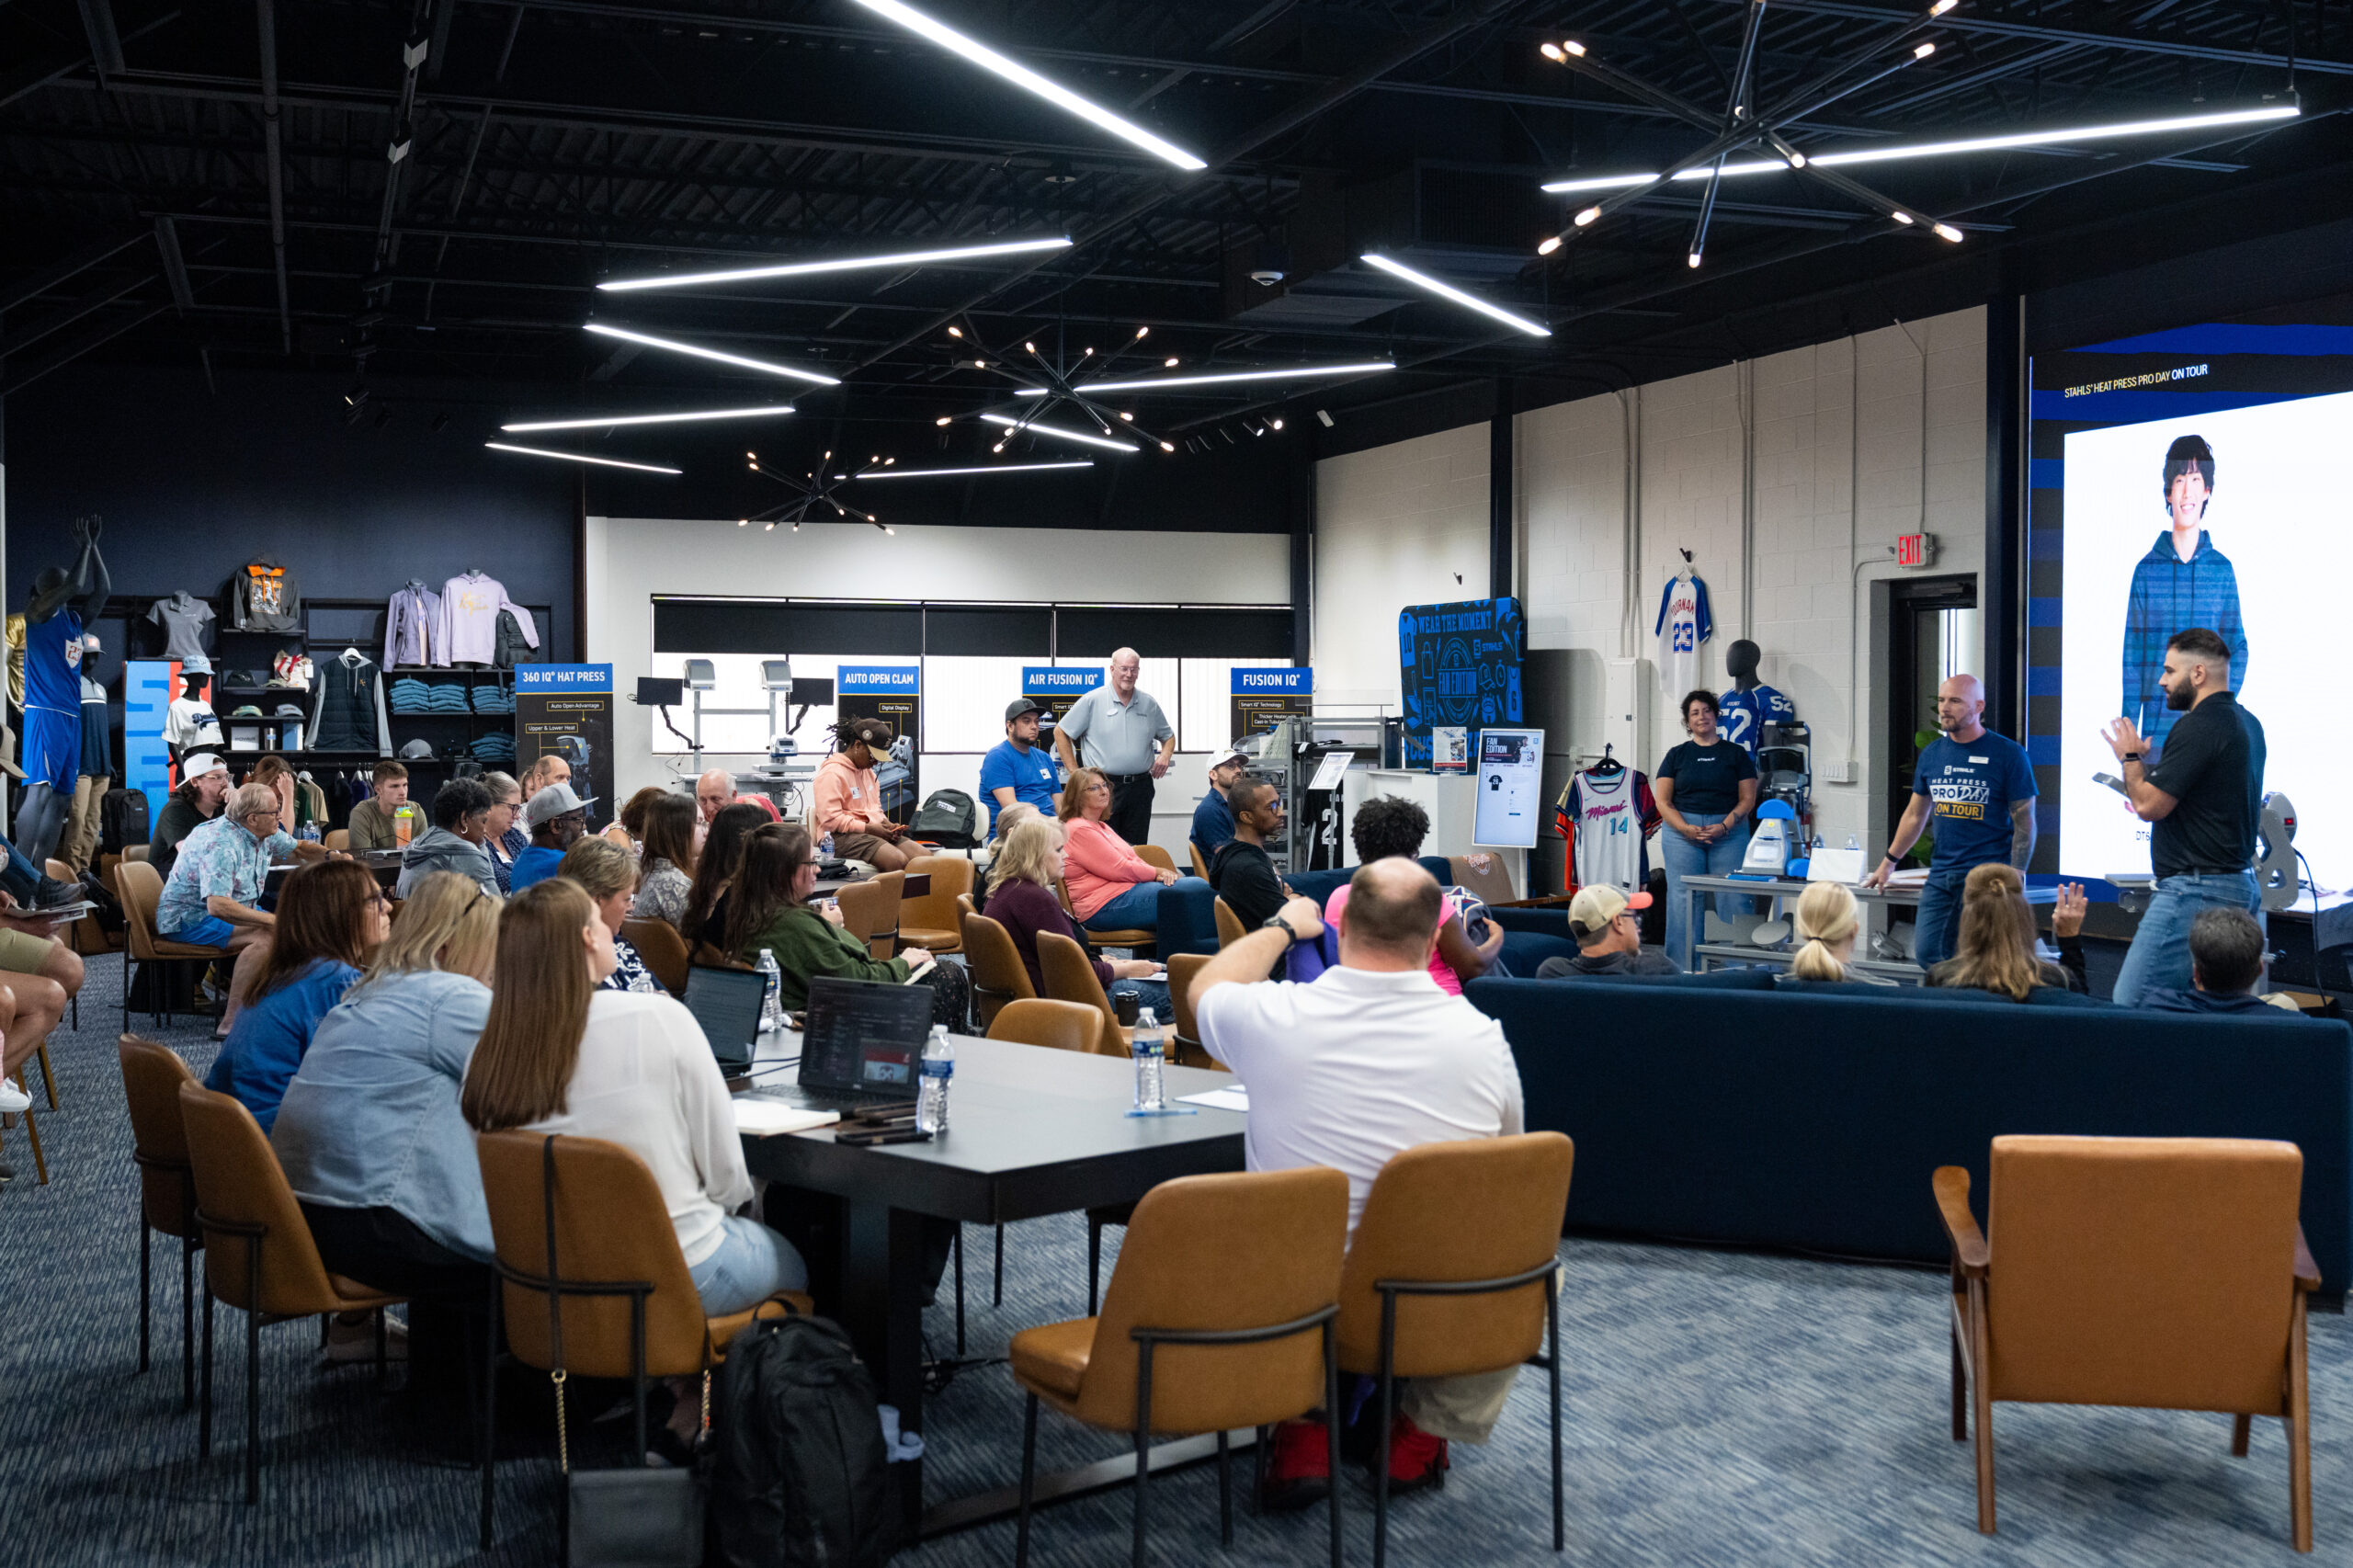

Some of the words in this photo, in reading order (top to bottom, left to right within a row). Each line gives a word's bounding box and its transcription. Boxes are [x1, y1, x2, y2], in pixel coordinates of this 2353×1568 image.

[2094, 381, 2112, 392] HEAT
[2113, 376, 2137, 391] PRESS
[2138, 373, 2154, 385] PRO
[2155, 370, 2171, 382] DAY
[2172, 368, 2185, 380] ON
[2186, 364, 2209, 378] TOUR
[1899, 535, 1922, 565] EXIT
[1417, 616, 1440, 633] WEAR
[1441, 614, 1458, 632] THE
[1458, 610, 1492, 631] MOMENT
[1673, 621, 1694, 653] 23
[522, 672, 540, 682] 360
[557, 672, 574, 682] HAT
[577, 671, 606, 682] PRESS
[845, 673, 868, 684] AUTO
[869, 674, 891, 684] OPEN
[892, 674, 914, 685] CLAM
[1029, 674, 1045, 685] AIR
[1048, 674, 1083, 685] FUSION
[1243, 674, 1282, 686] FUSION
[1769, 696, 1793, 713] 52
[1486, 737, 1498, 745] FAN
[1485, 745, 1507, 754] EDITION
[1957, 778, 1987, 787] PRESS
[1933, 788, 1956, 799] PRO
[1957, 786, 1989, 802] DAY
[1586, 800, 1629, 821] Miami
[1937, 803, 1949, 813] ON
[1951, 804, 1979, 817] TOUR
[1609, 816, 1629, 835] 14
